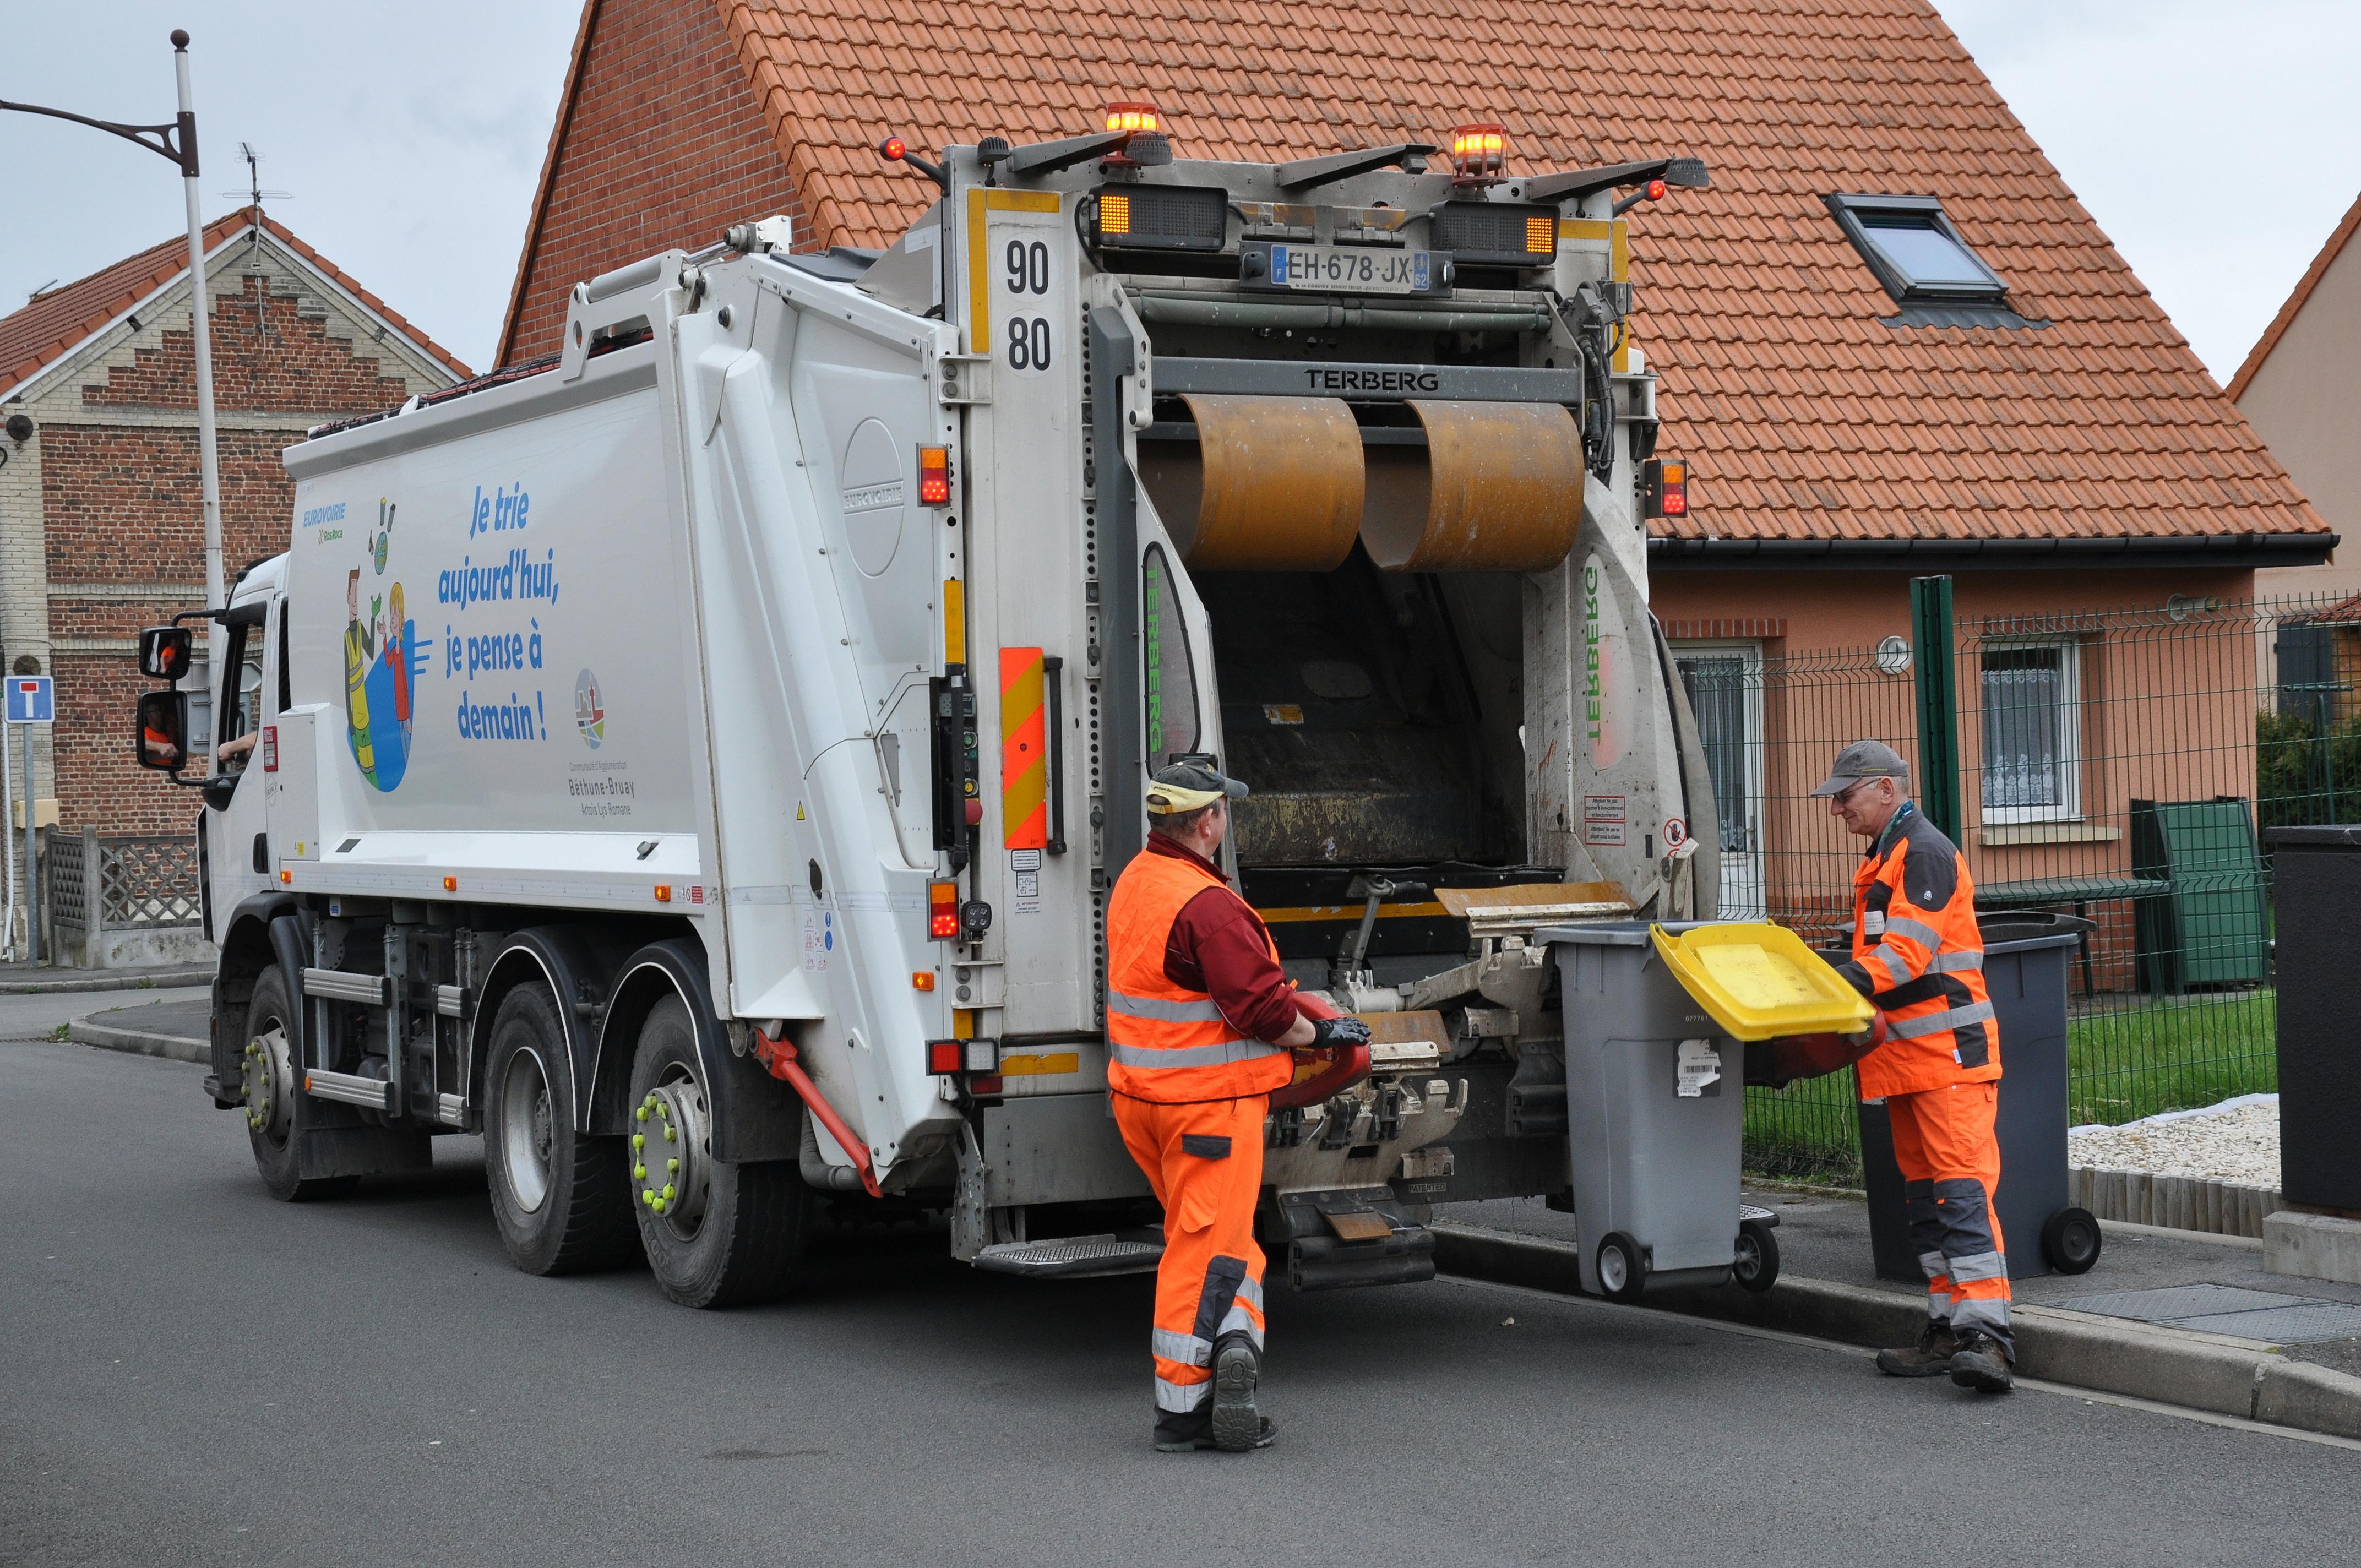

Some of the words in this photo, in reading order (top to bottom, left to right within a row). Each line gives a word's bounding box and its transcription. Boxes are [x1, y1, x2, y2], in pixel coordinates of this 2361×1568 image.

[1007, 239, 1049, 295] 90
[1277, 268, 1281, 277] F
[1288, 252, 1410, 284] EH-678-JX
[1414, 273, 1428, 287] 62
[1008, 317, 1051, 371] 80
[1303, 369, 1439, 391] TERBERG
[303, 502, 346, 527] EUROVOIRIE
[470, 485, 490, 541] Je
[494, 481, 529, 531] trie
[844, 486, 902, 509] EUROVOIRIE
[438, 547, 559, 611] aujourd'hui,
[445, 624, 463, 680] je
[468, 633, 523, 681] pense
[529, 617, 542, 669] à
[1147, 562, 1163, 753] TERBERG
[1585, 566, 1601, 747] TERBERG
[458, 690, 534, 740] demain
[537, 690, 546, 741] !
[568, 777, 635, 799] Béthune-Bruay
[581, 803, 597, 816] Artois
[597, 802, 608, 819] Lys
[608, 802, 632, 815] Romane
[1409, 1183, 1446, 1194] PATENTED
